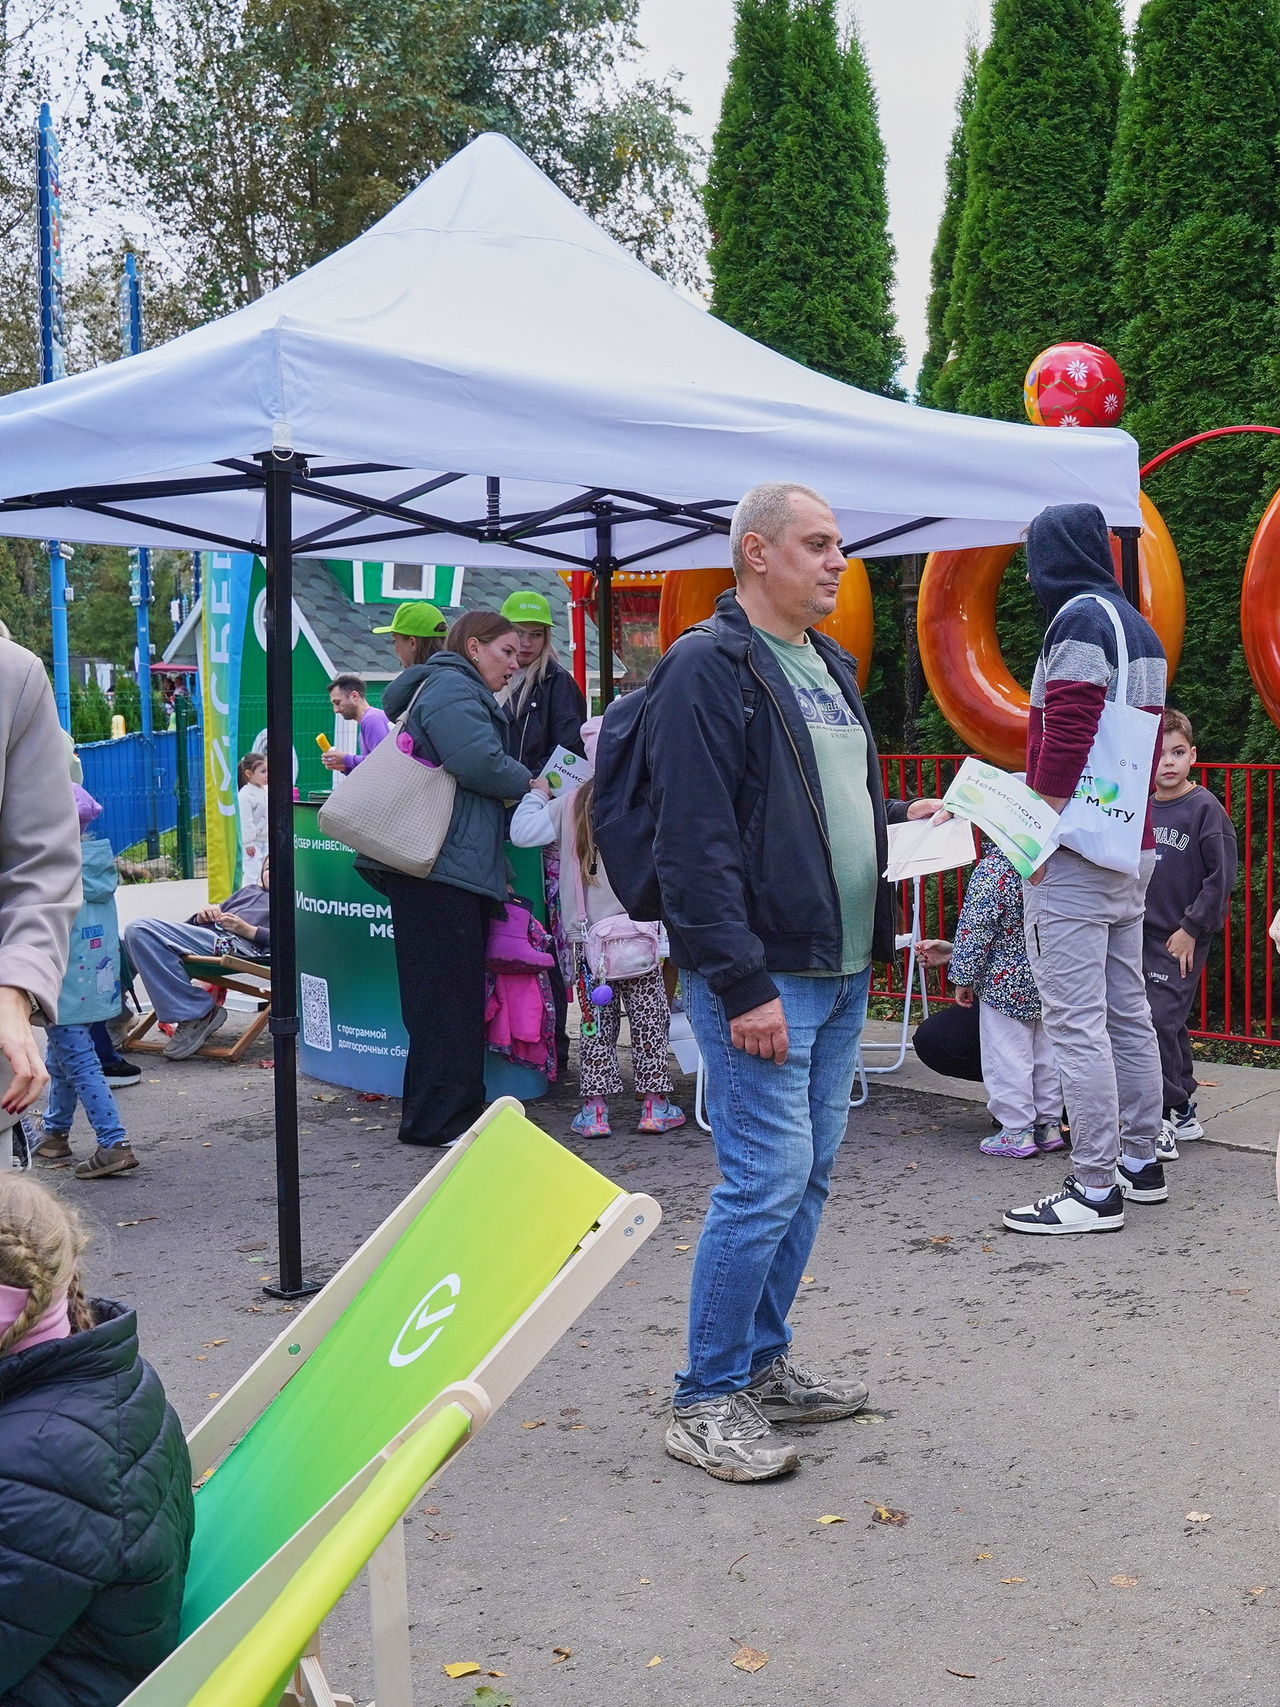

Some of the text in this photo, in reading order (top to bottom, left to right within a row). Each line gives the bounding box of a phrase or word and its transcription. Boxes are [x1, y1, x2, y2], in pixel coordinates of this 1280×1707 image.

[553, 762, 587, 784] Некис
[966, 776, 1042, 830] Некислого
[295, 890, 393, 920] Исполняем
[336, 1024, 387, 1040] с программой
[338, 1039, 389, 1056] долгосрочных
